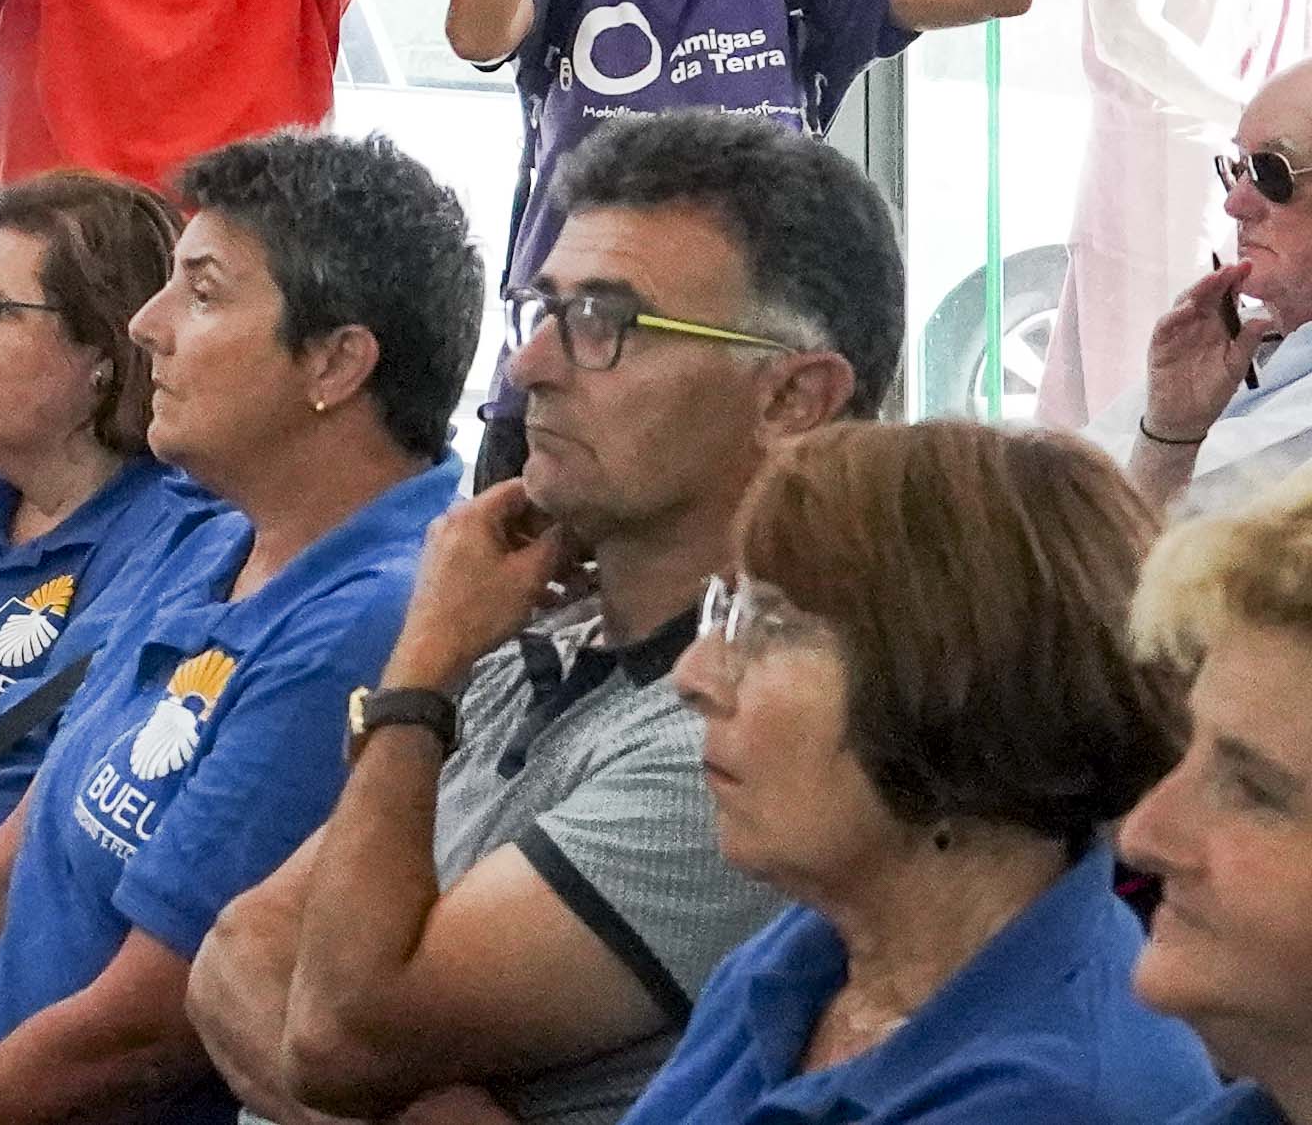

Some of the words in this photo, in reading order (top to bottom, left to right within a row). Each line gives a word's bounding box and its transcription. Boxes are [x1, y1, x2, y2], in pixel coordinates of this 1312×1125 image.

[669, 28, 767, 63] Amigas
[670, 61, 703, 84] da
[708, 48, 787, 74] Terra
